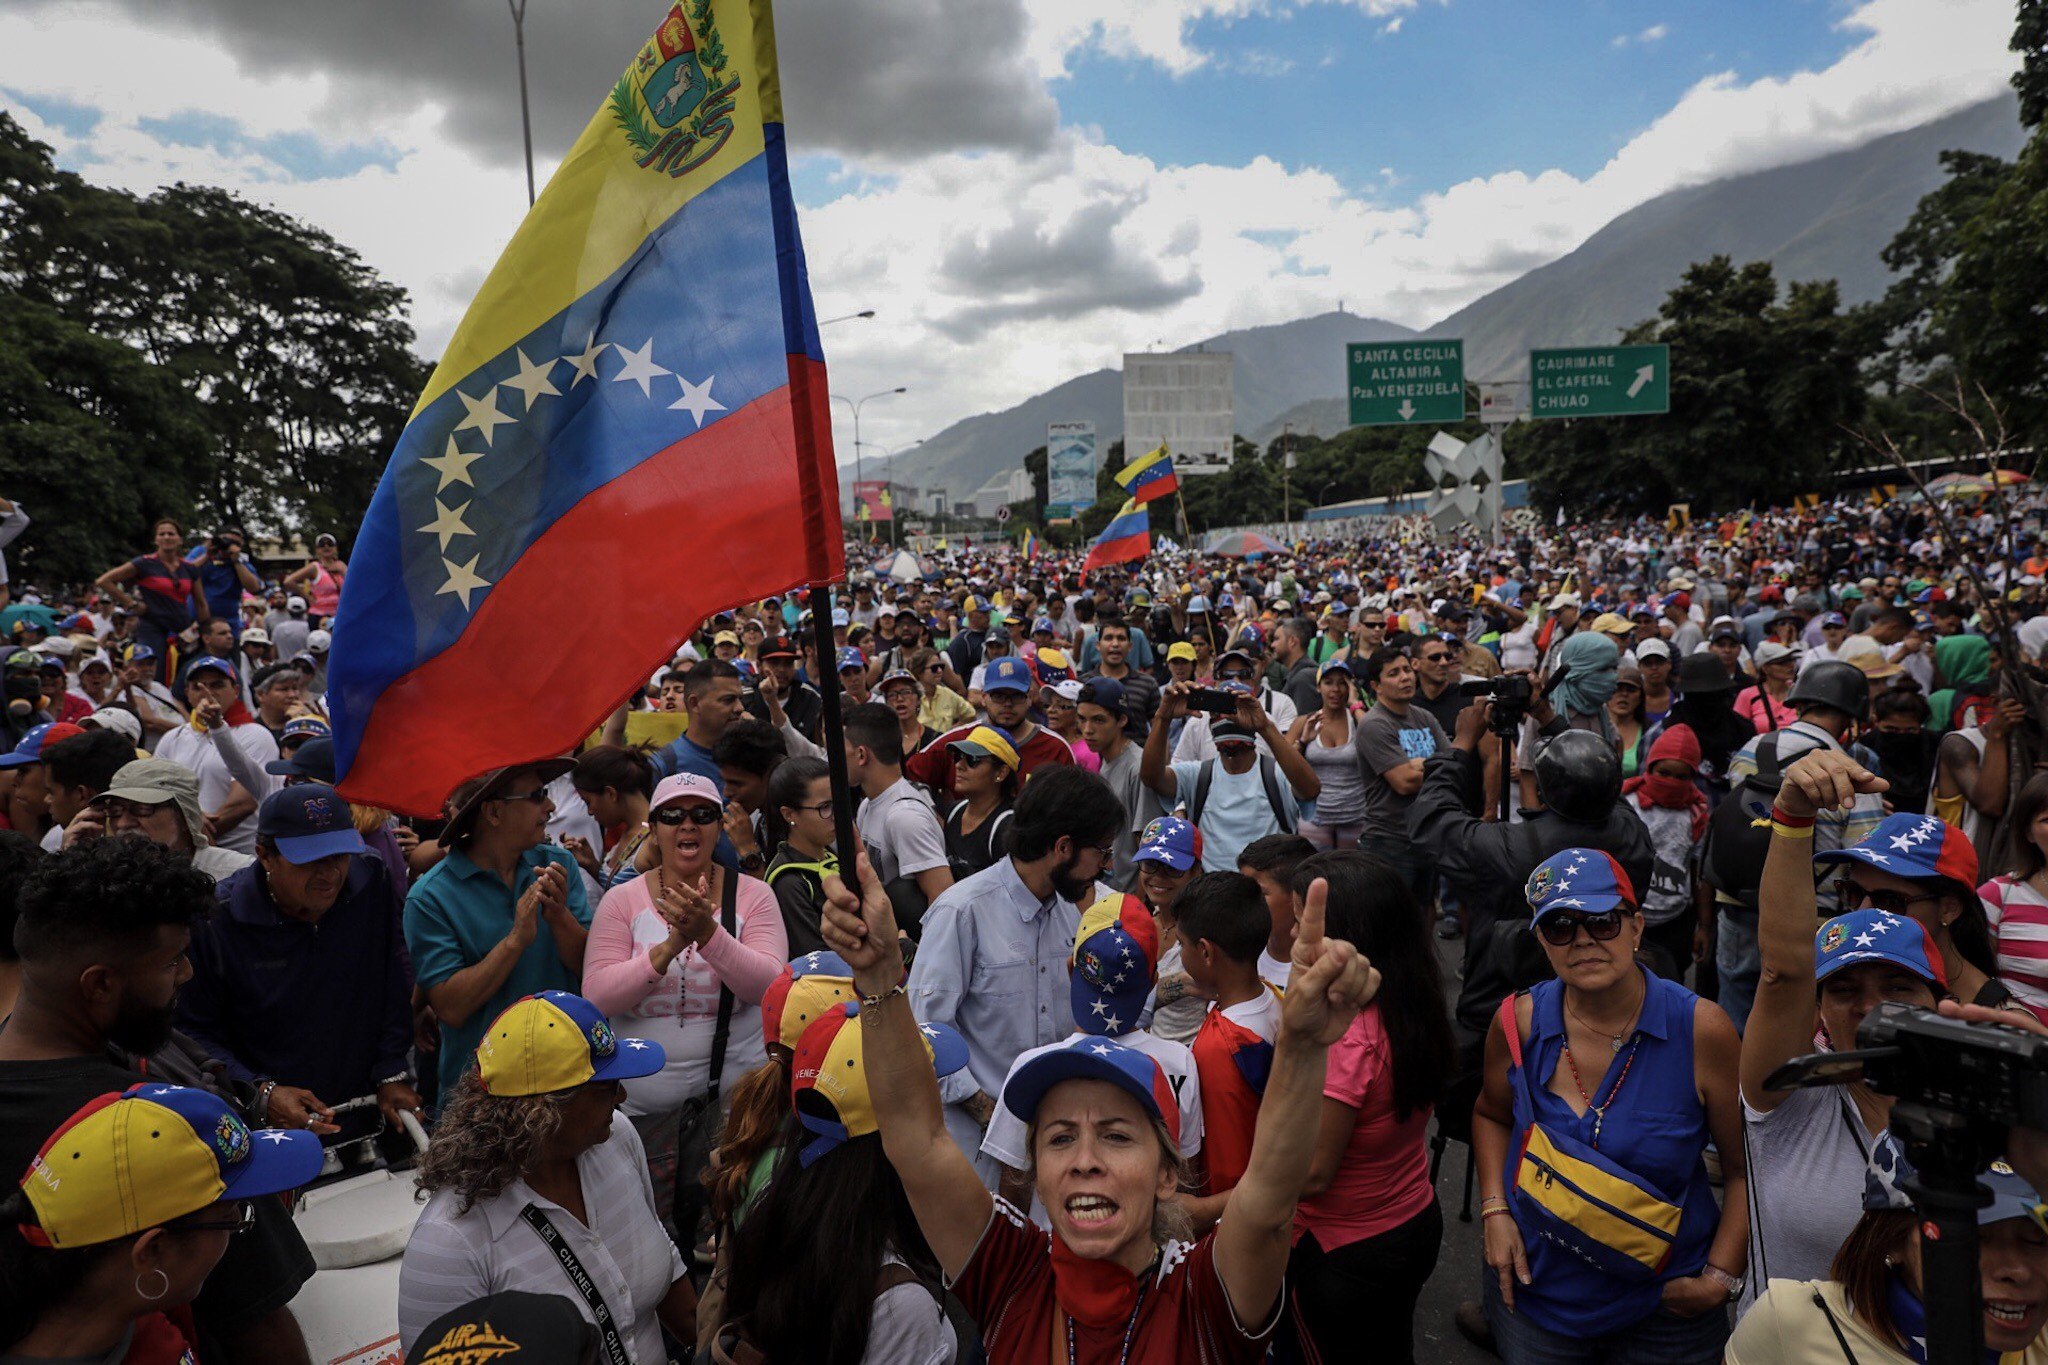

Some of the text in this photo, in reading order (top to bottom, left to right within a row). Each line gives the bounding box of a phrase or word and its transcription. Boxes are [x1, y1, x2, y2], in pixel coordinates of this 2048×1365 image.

[1354, 347, 1458, 363] SANTA CECILIA
[1537, 355, 1615, 371] CAURIMARE
[1371, 365, 1442, 380] ALTAMIRA
[1537, 374, 1612, 389] EL CAFETAL
[1377, 382, 1460, 397] VENEZUELA
[1538, 394, 1589, 408] CHUAO
[560, 1248, 593, 1299] CHANEL
[439, 1323, 477, 1350] AIR
